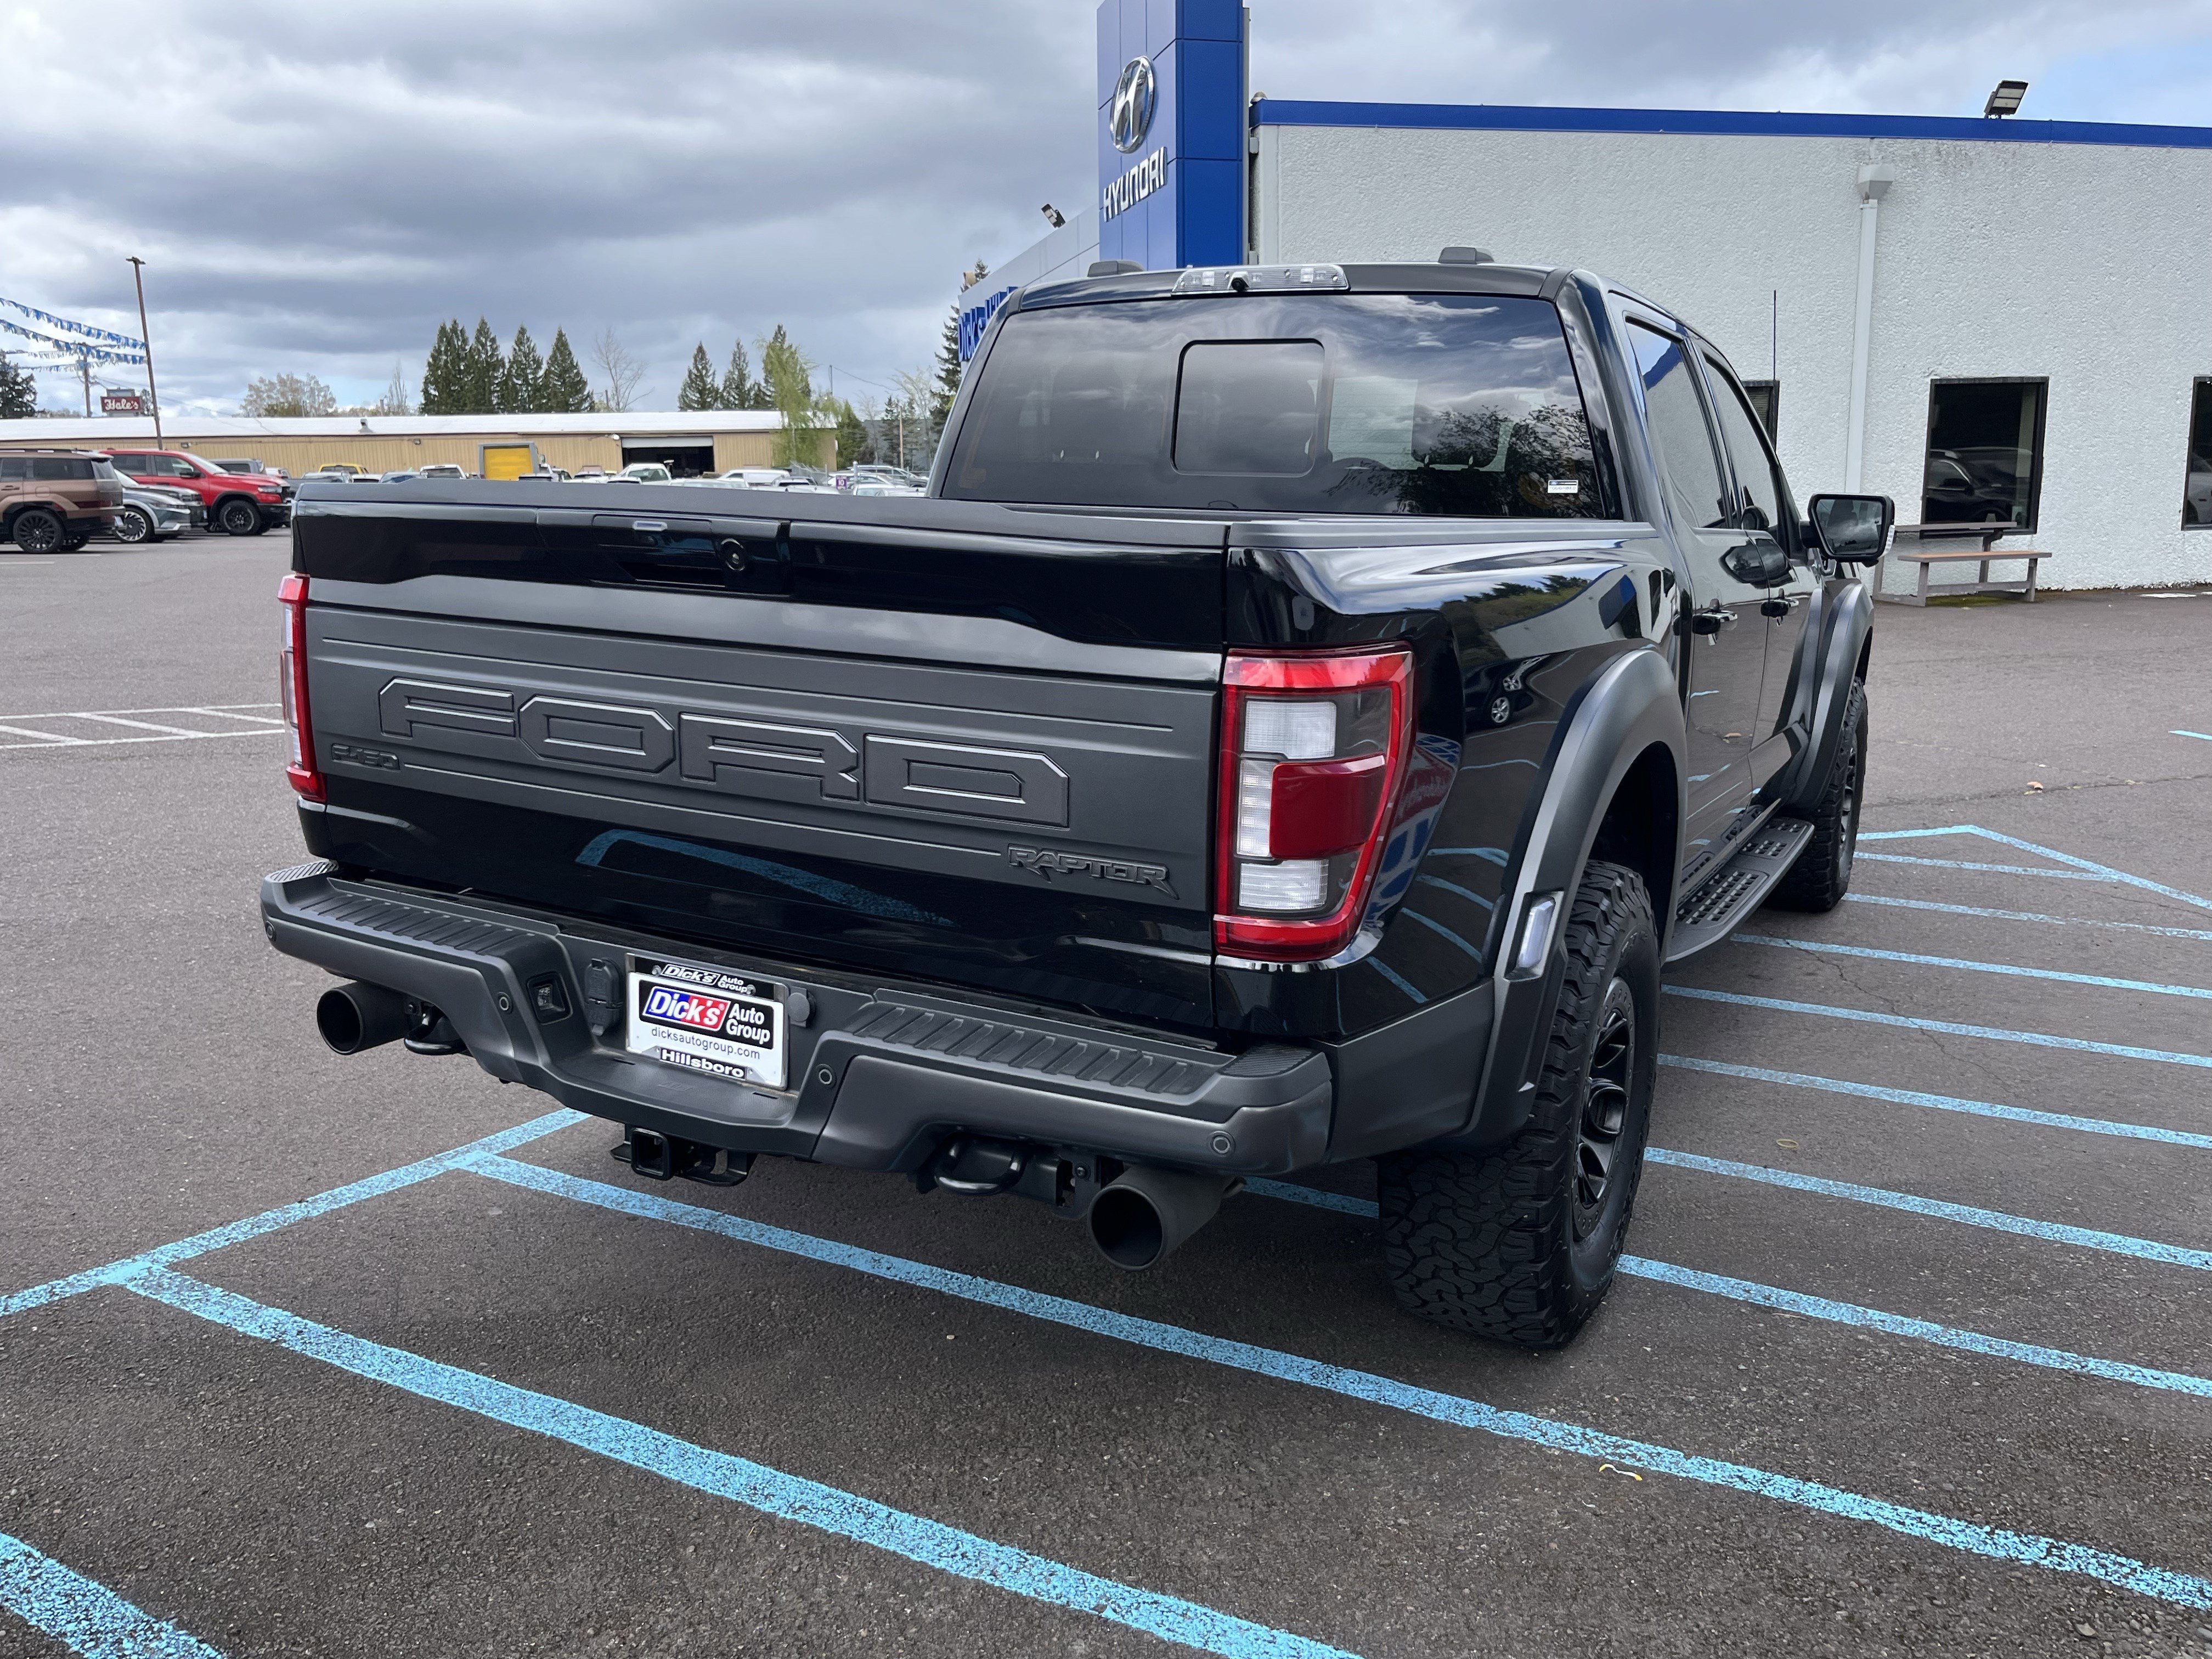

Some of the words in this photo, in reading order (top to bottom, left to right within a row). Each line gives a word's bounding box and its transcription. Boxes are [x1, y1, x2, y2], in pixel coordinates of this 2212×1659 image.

[1103, 146, 1166, 222] HYUNDAI
[104, 398, 139, 410] Hale's
[379, 676, 1070, 831] FORD
[1008, 843, 1179, 900] RAPTOR
[664, 965, 714, 983] Dick's
[718, 980, 747, 993] Group
[720, 975, 744, 985] Auto
[651, 991, 721, 1025] Dick's
[729, 1003, 765, 1025] Auto
[651, 1027, 760, 1059] dicksautogroup.com
[726, 1019, 771, 1044] Group
[662, 1049, 744, 1078] Hillsboro
